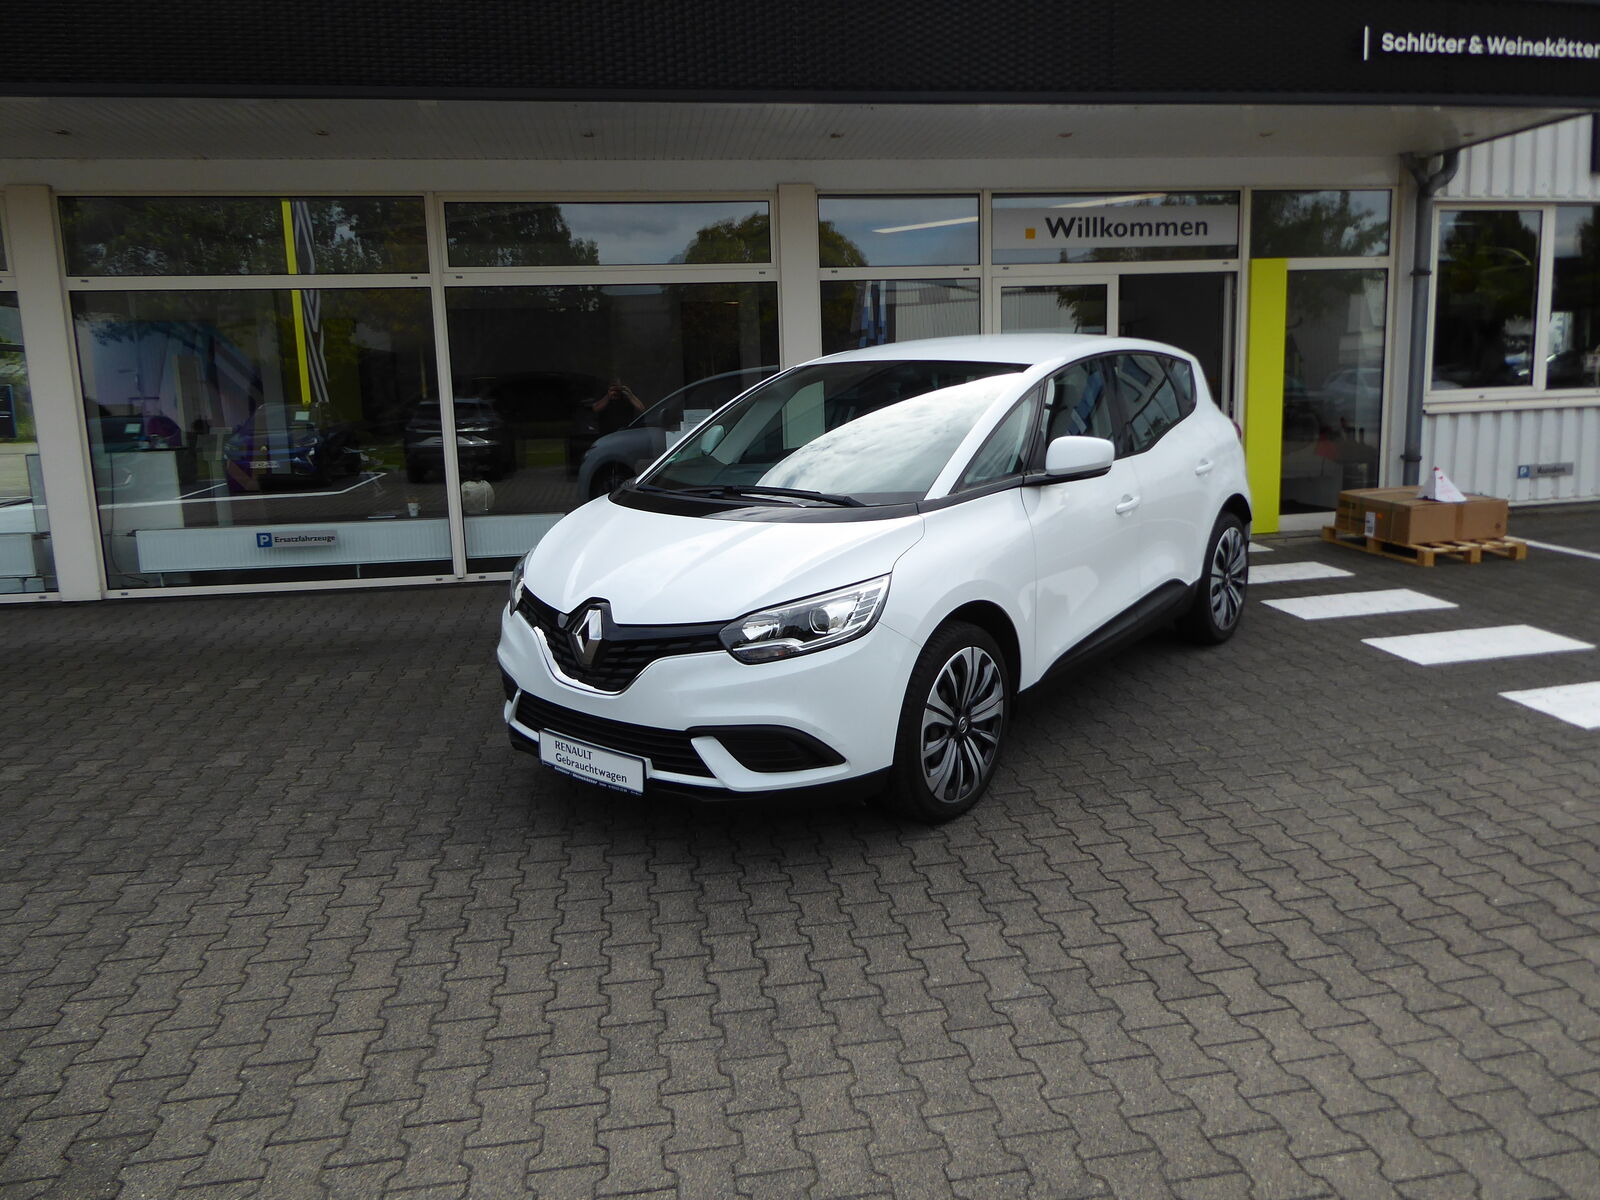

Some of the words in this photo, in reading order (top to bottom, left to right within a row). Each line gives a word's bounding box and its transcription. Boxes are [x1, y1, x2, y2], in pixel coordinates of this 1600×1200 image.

[1382, 32, 1466, 53] Schlüter
[1468, 35, 1483, 54] &
[1487, 35, 1600, 58] Weinekötter
[1045, 216, 1208, 238] Willkommen
[260, 534, 270, 546] P
[274, 535, 336, 543] Ersatzfahrzeuge
[555, 741, 592, 760] RENAULT
[555, 753, 627, 783] Gebrauchtwagen
